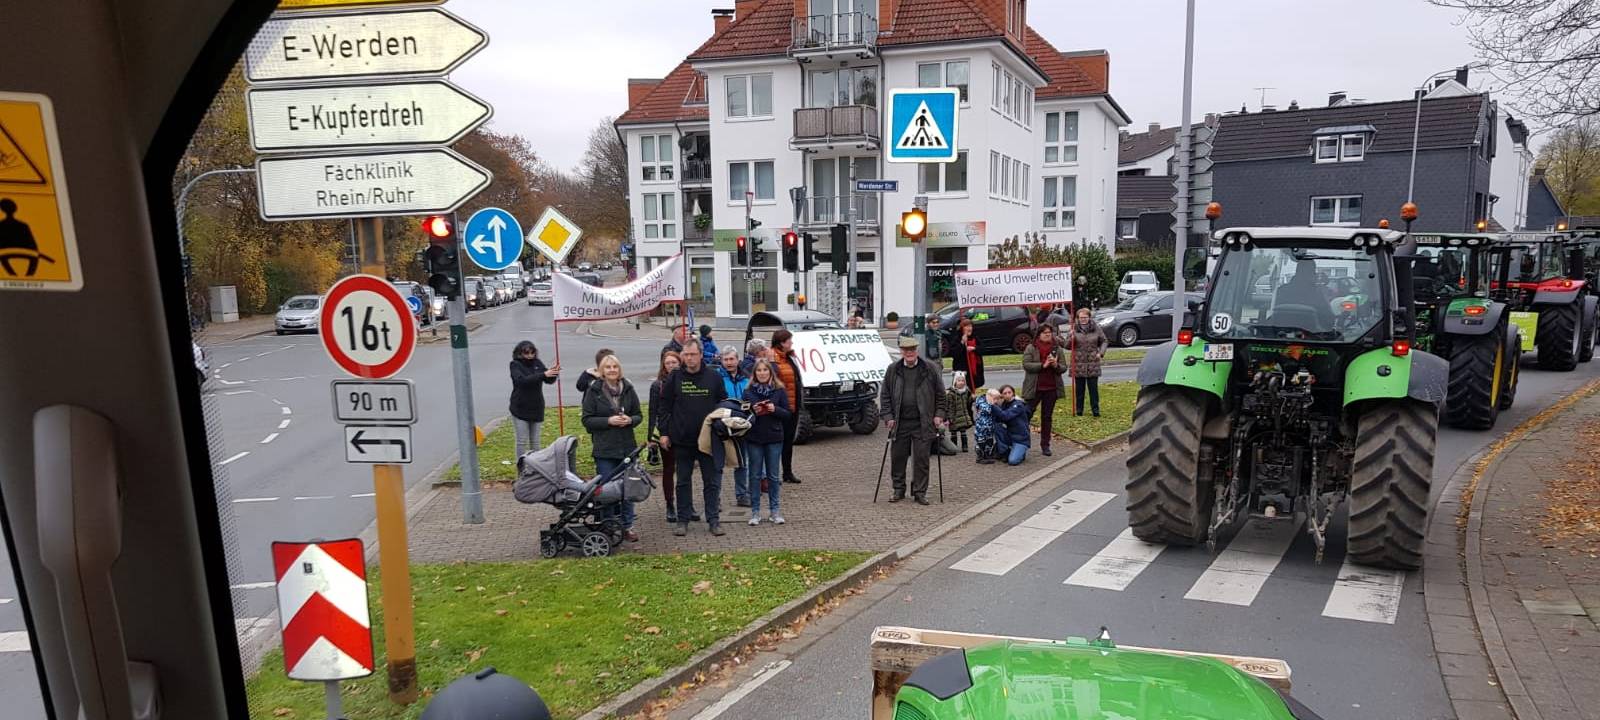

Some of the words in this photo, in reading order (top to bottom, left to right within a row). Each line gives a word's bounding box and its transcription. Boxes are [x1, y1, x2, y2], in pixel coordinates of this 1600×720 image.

[282, 31, 418, 61] E-Werden
[287, 101, 424, 134] E-Kupferdreh
[324, 161, 413, 181] Fachklinik
[316, 187, 415, 207] Rhein/Ruhr
[982, 274, 1000, 285] und
[1004, 271, 1070, 283] Umweltrecht
[582, 292, 604, 304] MIT
[633, 280, 664, 300] NICHT
[961, 294, 1015, 305] blockieren
[1019, 290, 1064, 302] Tierwohl!
[563, 305, 600, 317] gegen
[1214, 315, 1229, 330] 50
[819, 333, 880, 345] FARMERS
[793, 348, 825, 372] NO
[828, 352, 865, 364] FOOD
[836, 369, 885, 380] FUTURE
[350, 392, 372, 411] 90
[380, 397, 397, 411] m
